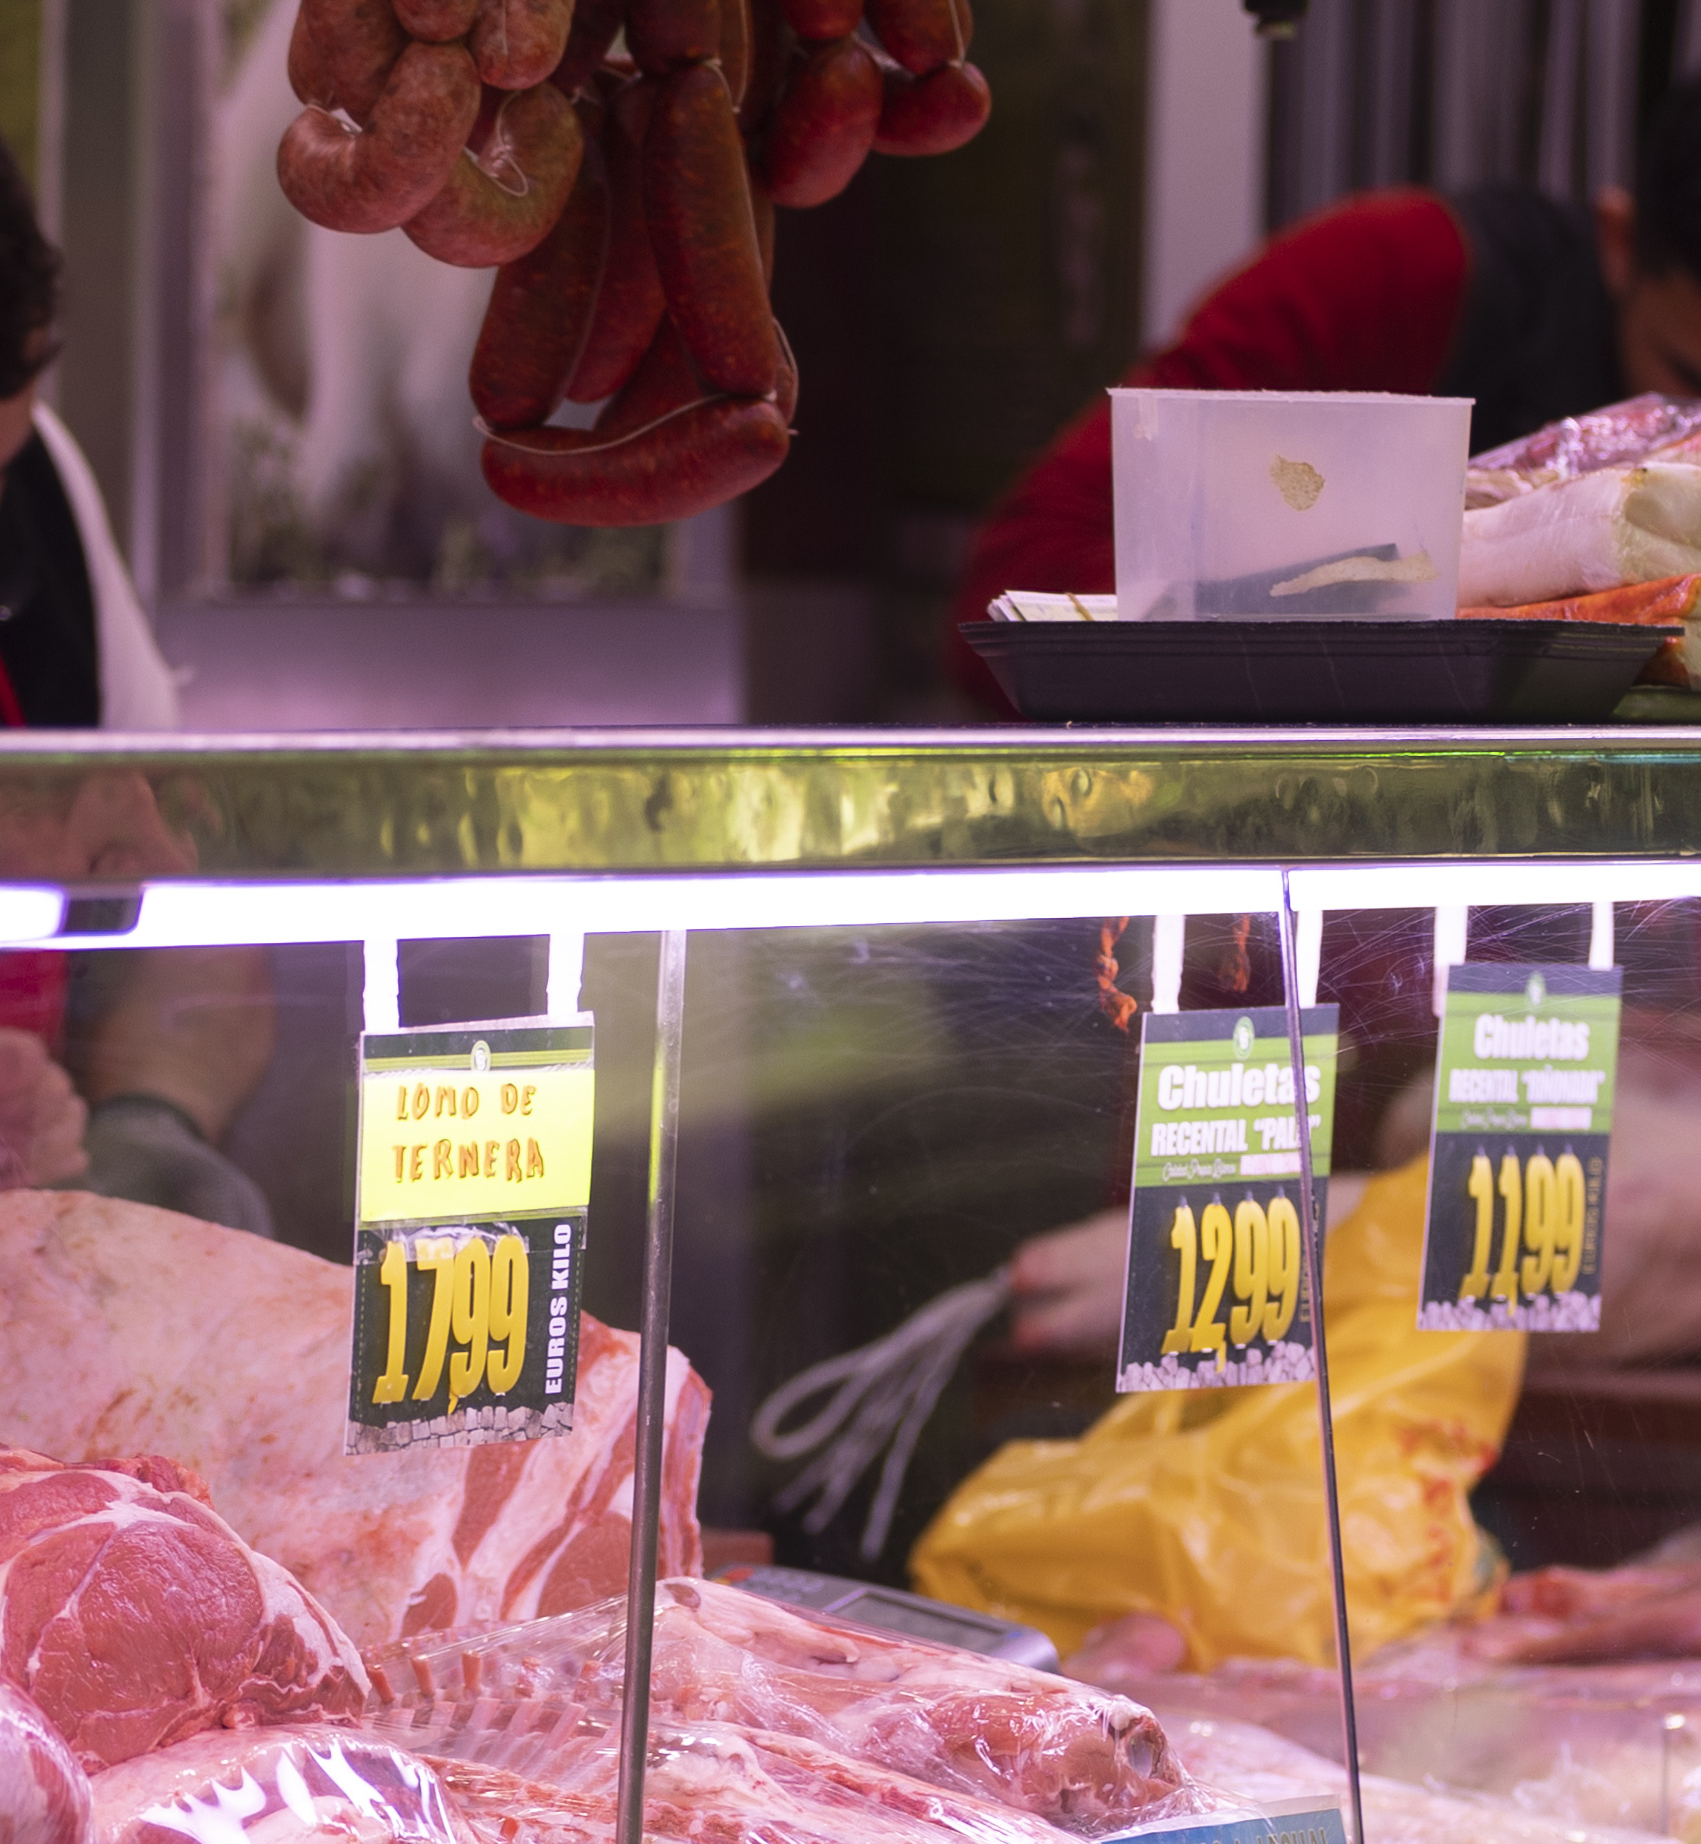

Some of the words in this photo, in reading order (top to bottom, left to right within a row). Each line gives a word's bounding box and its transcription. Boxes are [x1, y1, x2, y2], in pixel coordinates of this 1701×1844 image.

[1474, 1014, 1590, 1060] Chuletas
[396, 1083, 480, 1121] LOMO
[501, 1083, 537, 1117] DE
[1158, 1063, 1321, 1110] Chuletas
[1151, 1119, 1248, 1156] RECENTAL
[392, 1138, 545, 1184] TERNERA
[552, 1224, 571, 1289] KILO
[545, 1297, 568, 1394] EUROS
